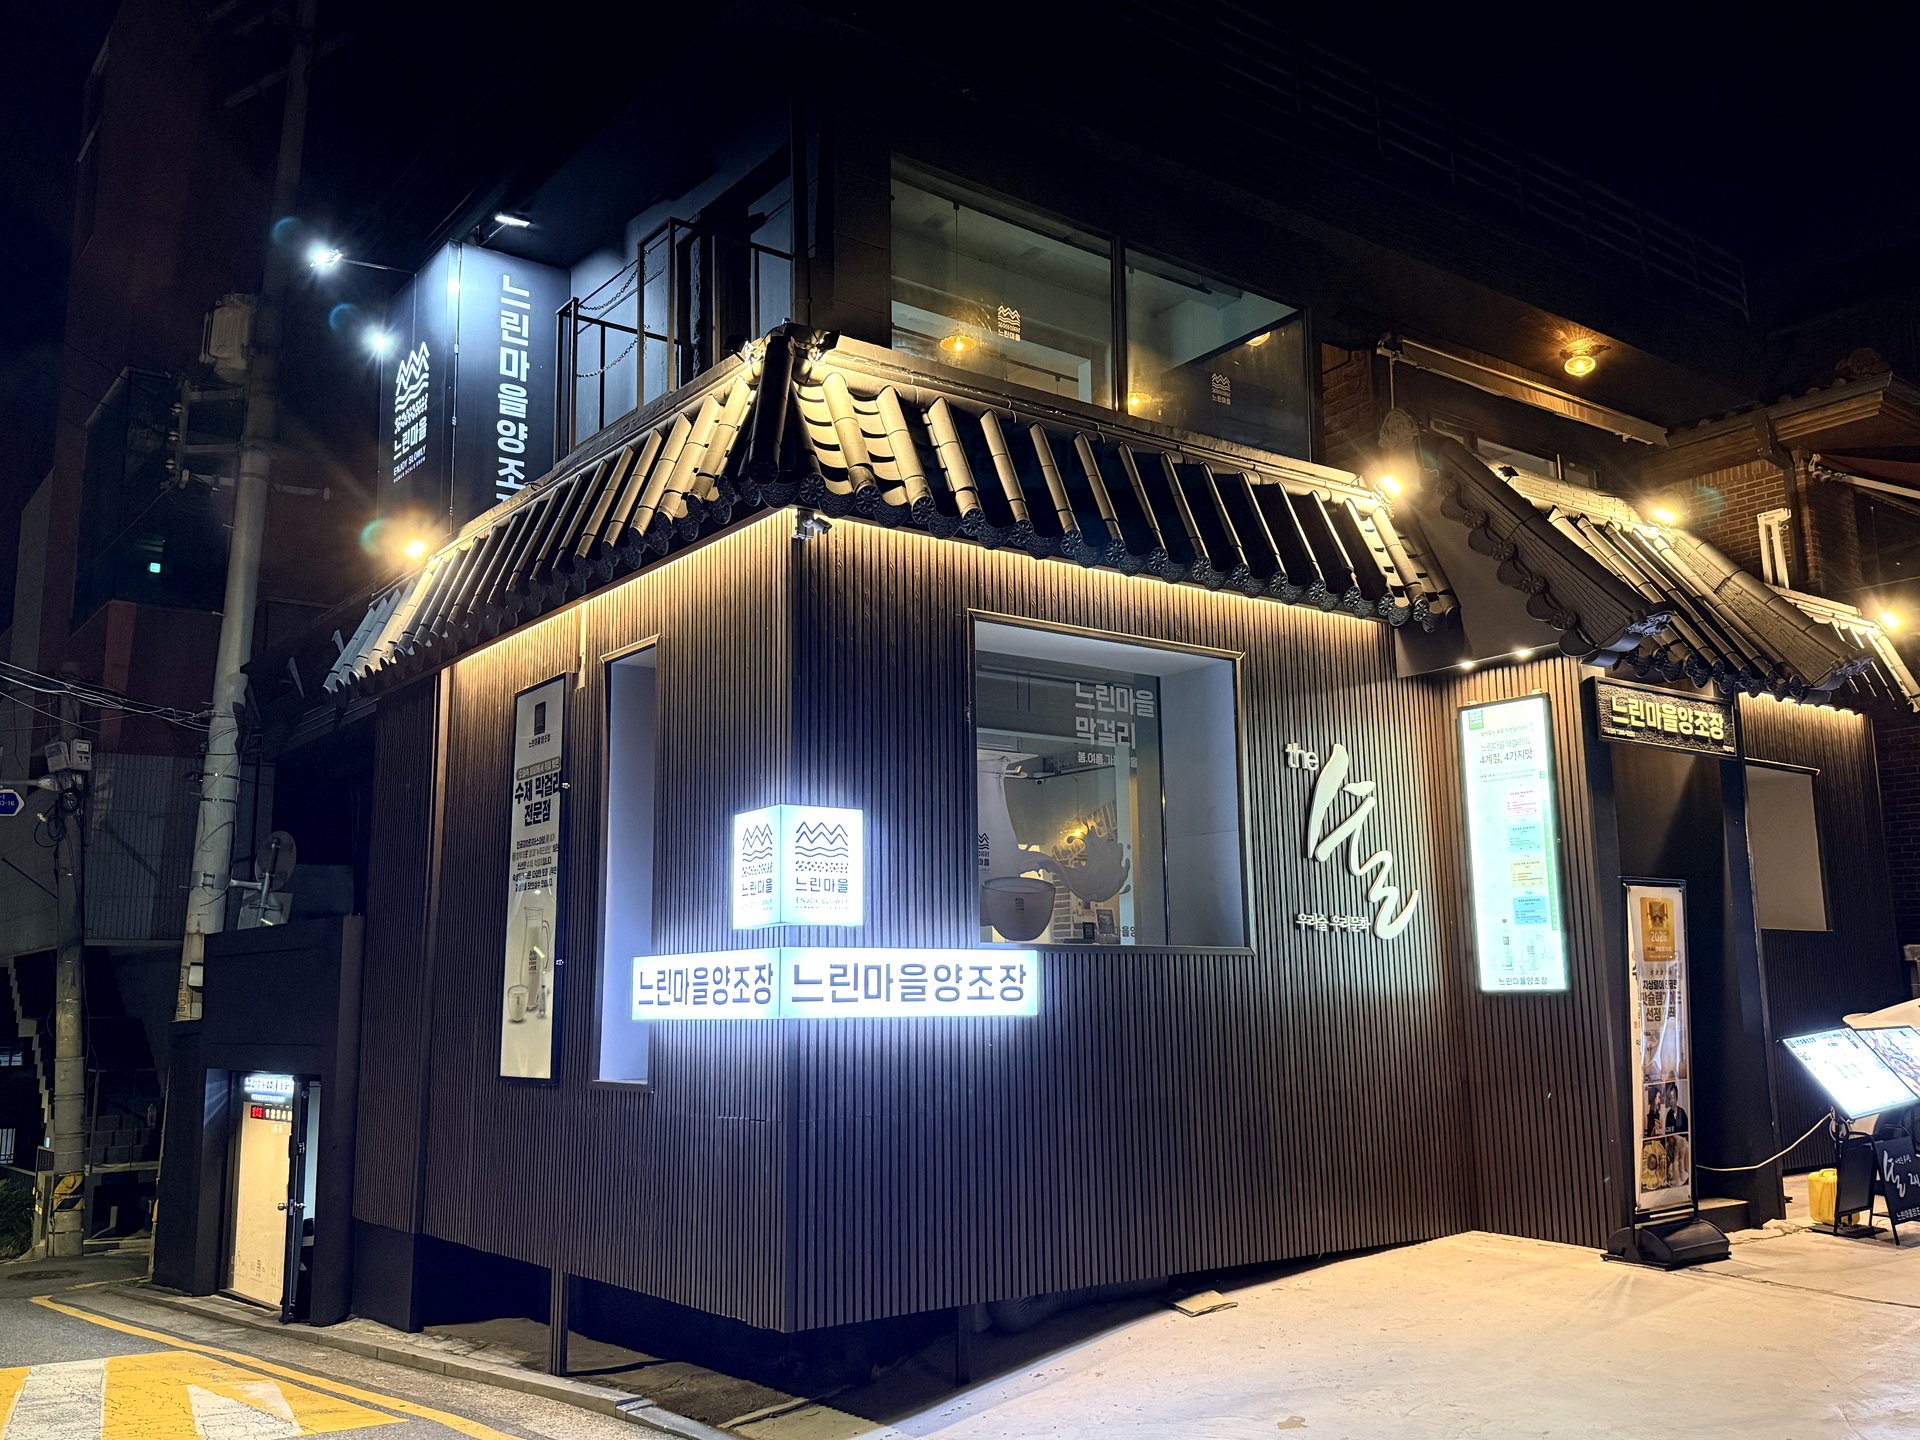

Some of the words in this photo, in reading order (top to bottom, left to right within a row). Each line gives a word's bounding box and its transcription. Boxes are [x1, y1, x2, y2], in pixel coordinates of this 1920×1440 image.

[496, 274, 530, 501] 느린마을양조
[394, 416, 427, 460] 느린마을
[1075, 682, 1155, 718] 느린마을
[1075, 716, 1137, 750] 막걸리
[1611, 695, 1724, 741] 느린마을양조장
[1285, 742, 1319, 771] the
[515, 779, 533, 804] 수제
[535, 771, 561, 798] 막걸리
[524, 798, 551, 827] 전문점
[742, 878, 773, 897] 느린마을
[795, 877, 848, 894] 느린마을
[1296, 912, 1329, 932] 우리술
[1329, 914, 1371, 934] 우리문화
[639, 962, 774, 1007] 느린마을양조장
[791, 963, 1027, 1004] 느린마을양조장
[1499, 976, 1548, 986] 느린마을양조장
[1646, 1007, 1662, 1022] 선정
